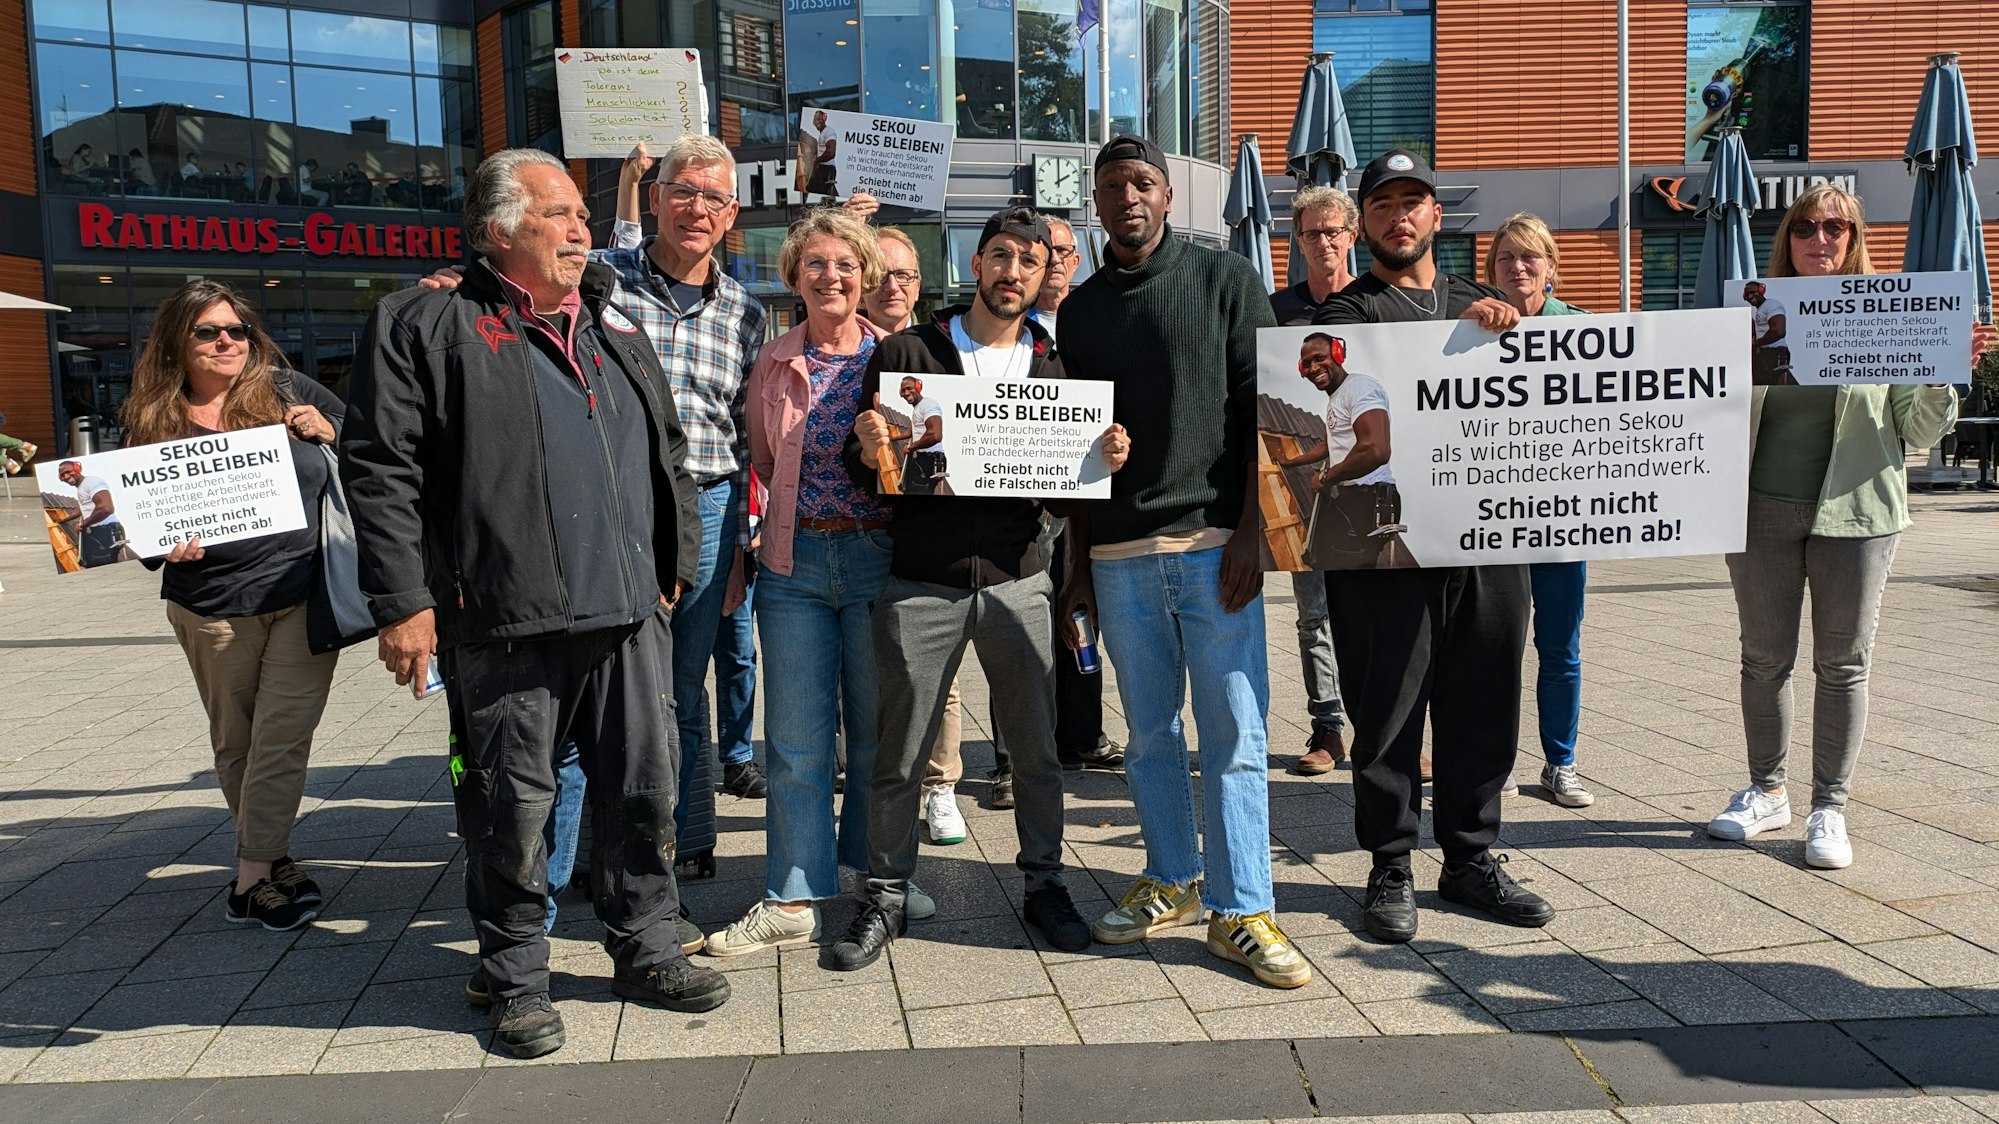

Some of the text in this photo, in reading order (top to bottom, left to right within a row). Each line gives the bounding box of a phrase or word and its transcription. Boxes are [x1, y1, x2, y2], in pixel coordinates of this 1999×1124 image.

[616, 67, 632, 75] ist
[582, 80, 632, 91] Toleranz
[587, 97, 666, 106] Menschlichkeit
[871, 119, 916, 136] SEKOU
[589, 132, 654, 142] Fairness
[844, 131, 945, 155] MUSS BLEIBEN!
[847, 155, 934, 173] als wichtige Arbeitskraft
[857, 147, 928, 163] Wir brauchen Sekou
[846, 162, 935, 181] im Dachdeckerhandwerk.
[858, 175, 917, 192] Schiebt nicht
[868, 188, 906, 200] Falschen
[908, 193, 923, 203] ab!
[78, 202, 462, 258] RATHAUS-GALERIE
[1841, 278, 1912, 295] SEKOU
[1799, 296, 1960, 316] MUSS BLEIBEN!
[1821, 316, 1937, 328] Wir brauchen Sekou
[1806, 326, 1948, 339] als wichtige Arbeitskraft
[1499, 326, 1635, 364] SEKOU
[1806, 337, 1951, 349] im Dachdeckerhandwerk.
[1828, 352, 1923, 365] Schiebt nicht
[1819, 365, 1935, 378] die Falschen ab!
[995, 383, 1059, 401] SEKOU
[1417, 366, 1727, 411] MUSS BLEIBEN!
[955, 402, 1102, 424] MUSS BLEIBEN!
[976, 424, 1081, 437] Wir brauchen Sekou
[1461, 411, 1683, 438] Wir brauchen Sekou
[159, 437, 229, 462] SEKOU
[962, 435, 1091, 448] als wichtige Arbeitskraft
[1432, 432, 1704, 463] als wichtige Arbeitskraft
[962, 446, 1094, 460] im Dachdeckerhandwerk.
[121, 449, 280, 488] MUSS BLEIBEN!
[984, 463, 1069, 476] Schiebt nicht
[1432, 456, 1710, 486] im Dachdeckerhandwerk.
[147, 472, 262, 497] Wir brauchen Sekou
[974, 477, 1080, 491] die Falschen ab!
[136, 479, 274, 510] als wichtige Arbeitskraft
[137, 489, 280, 521] im Dachdeckerhandwerk.
[1478, 491, 1659, 521] Schiebt nicht
[164, 506, 258, 532] Schiebt nicht
[158, 517, 272, 547] die Falschen ab!
[1460, 519, 1682, 550] die Falschen ab!
